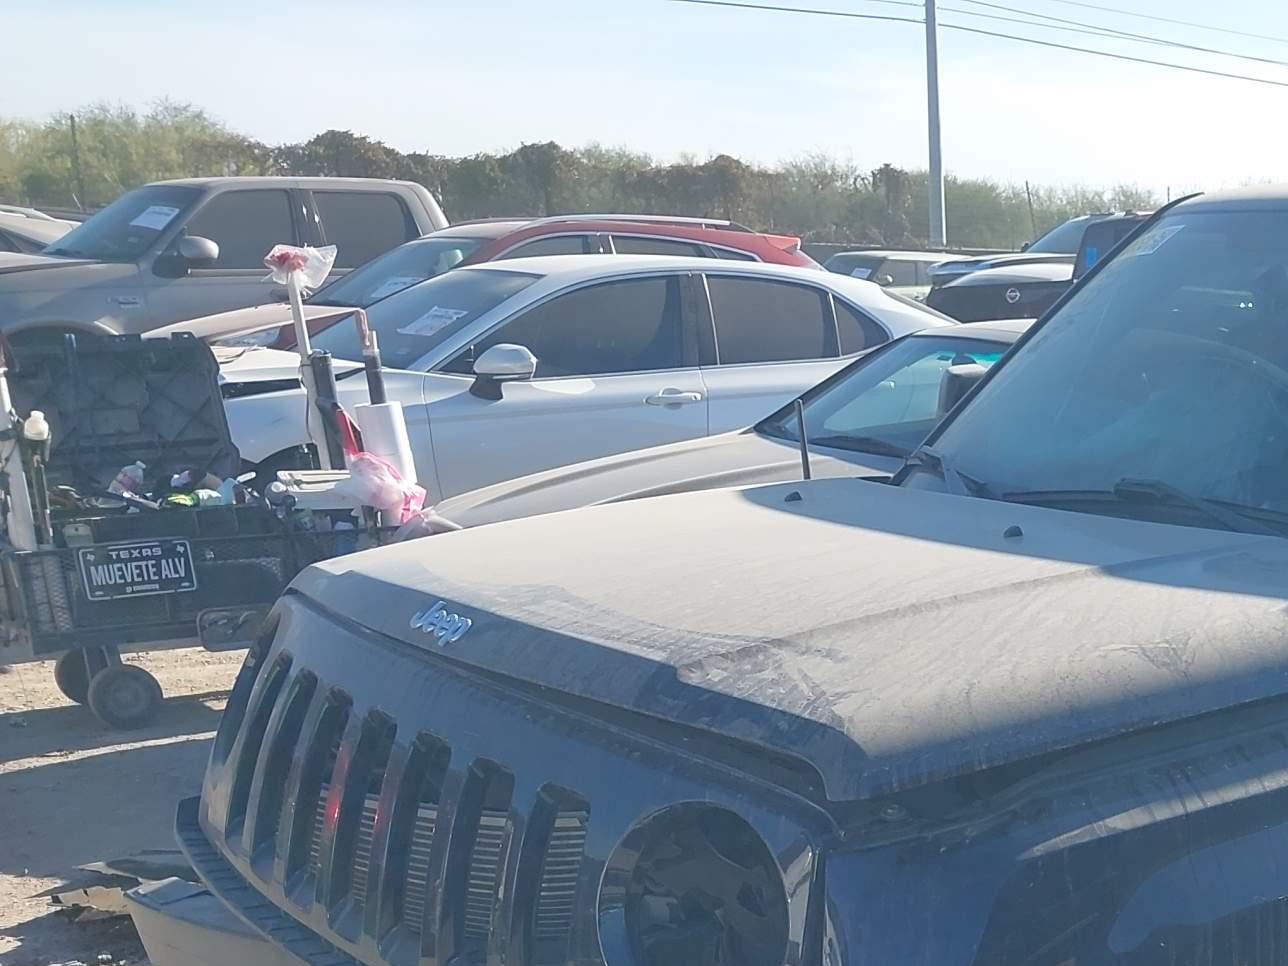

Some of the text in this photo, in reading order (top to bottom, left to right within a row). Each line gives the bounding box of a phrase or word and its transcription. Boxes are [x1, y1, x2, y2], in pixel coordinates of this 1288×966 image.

[108, 547, 162, 559] TEXAS
[90, 556, 185, 586] MUEVETE ALV
[409, 600, 473, 647] Jeep
